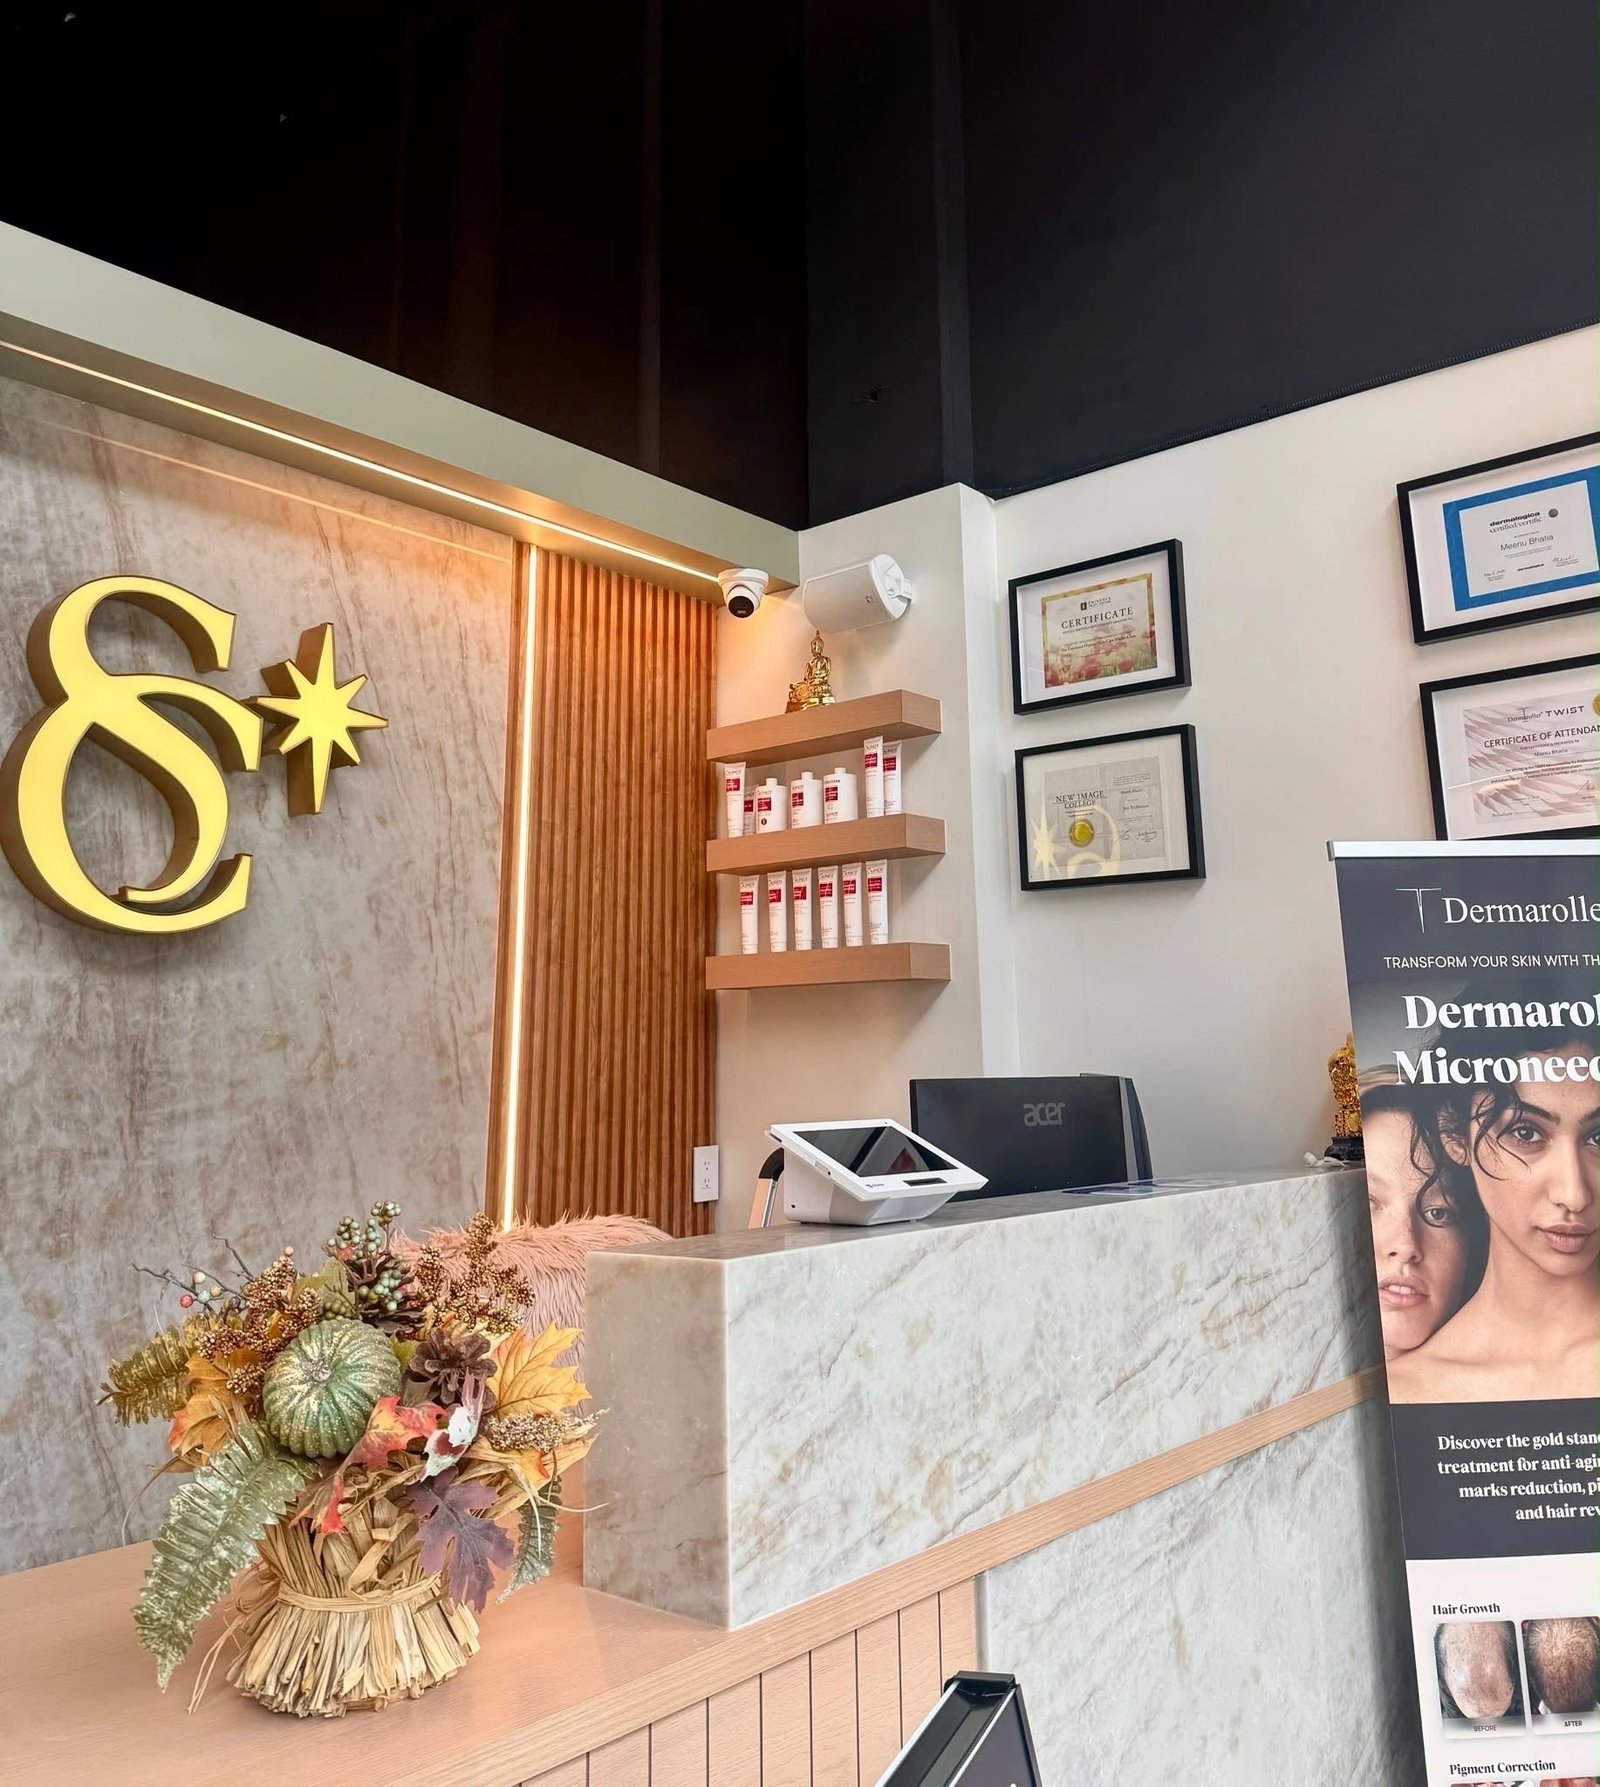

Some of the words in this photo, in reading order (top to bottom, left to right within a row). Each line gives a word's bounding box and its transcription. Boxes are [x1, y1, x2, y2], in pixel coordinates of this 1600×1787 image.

[1490, 512, 1540, 527] dermalogica
[1500, 541, 1527, 551] Meenu
[1529, 534, 1554, 545] Bhatia
[1061, 607, 1134, 629] CERTIFICATE
[1545, 705, 1584, 717] TWIST
[1484, 734, 1538, 748] CERTIFICATE
[1540, 732, 1553, 741] OF
[1056, 794, 1075, 803] NEW
[1077, 790, 1104, 800] IMAGE
[1064, 800, 1096, 809] COLLEGE
[1383, 956, 1467, 968] TRANSFORM
[1471, 955, 1508, 968] YOUR
[1512, 955, 1541, 967] SKIN
[1545, 954, 1579, 967] WITH
[1023, 1102, 1066, 1127] acer
[1437, 1435, 1503, 1450] Discover
[1506, 1434, 1530, 1448] the
[1532, 1432, 1564, 1450] gold
[1566, 1432, 1600, 1445] stan
[1437, 1461, 1515, 1475] treatment
[1517, 1457, 1539, 1472] for
[1459, 1483, 1508, 1498] marks
[1510, 1479, 1586, 1497] reduction,
[1515, 1505, 1544, 1520] and
[1546, 1503, 1577, 1519] hair
[1432, 1604, 1458, 1615] Hair
[1459, 1603, 1501, 1615] Growth
[1564, 1720, 1583, 1728] AFTER
[1449, 1763, 1495, 1777] Pigment
[1497, 1760, 1556, 1773] Correction
